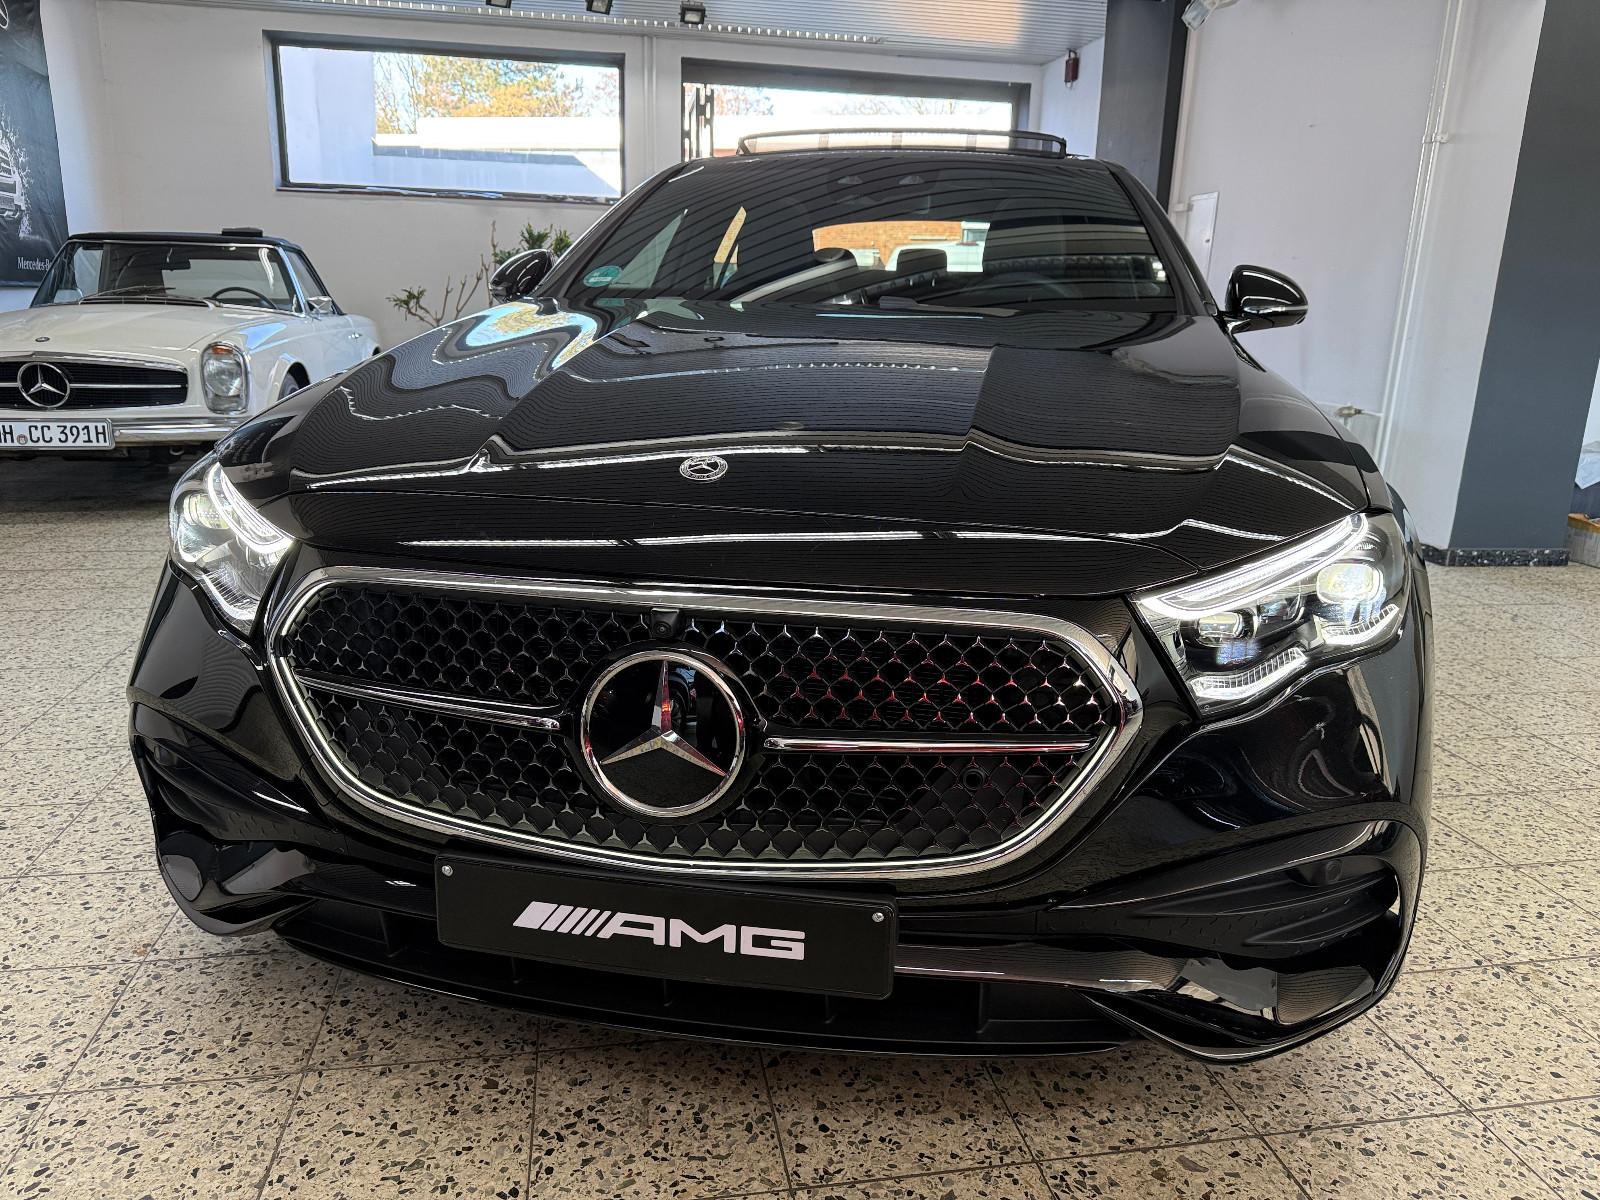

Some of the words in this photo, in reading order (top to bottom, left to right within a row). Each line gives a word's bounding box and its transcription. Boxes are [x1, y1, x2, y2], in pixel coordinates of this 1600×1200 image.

[0, 424, 15, 443] H
[28, 425, 54, 443] CC
[57, 425, 107, 443] 391H
[597, 911, 806, 961] AMG
